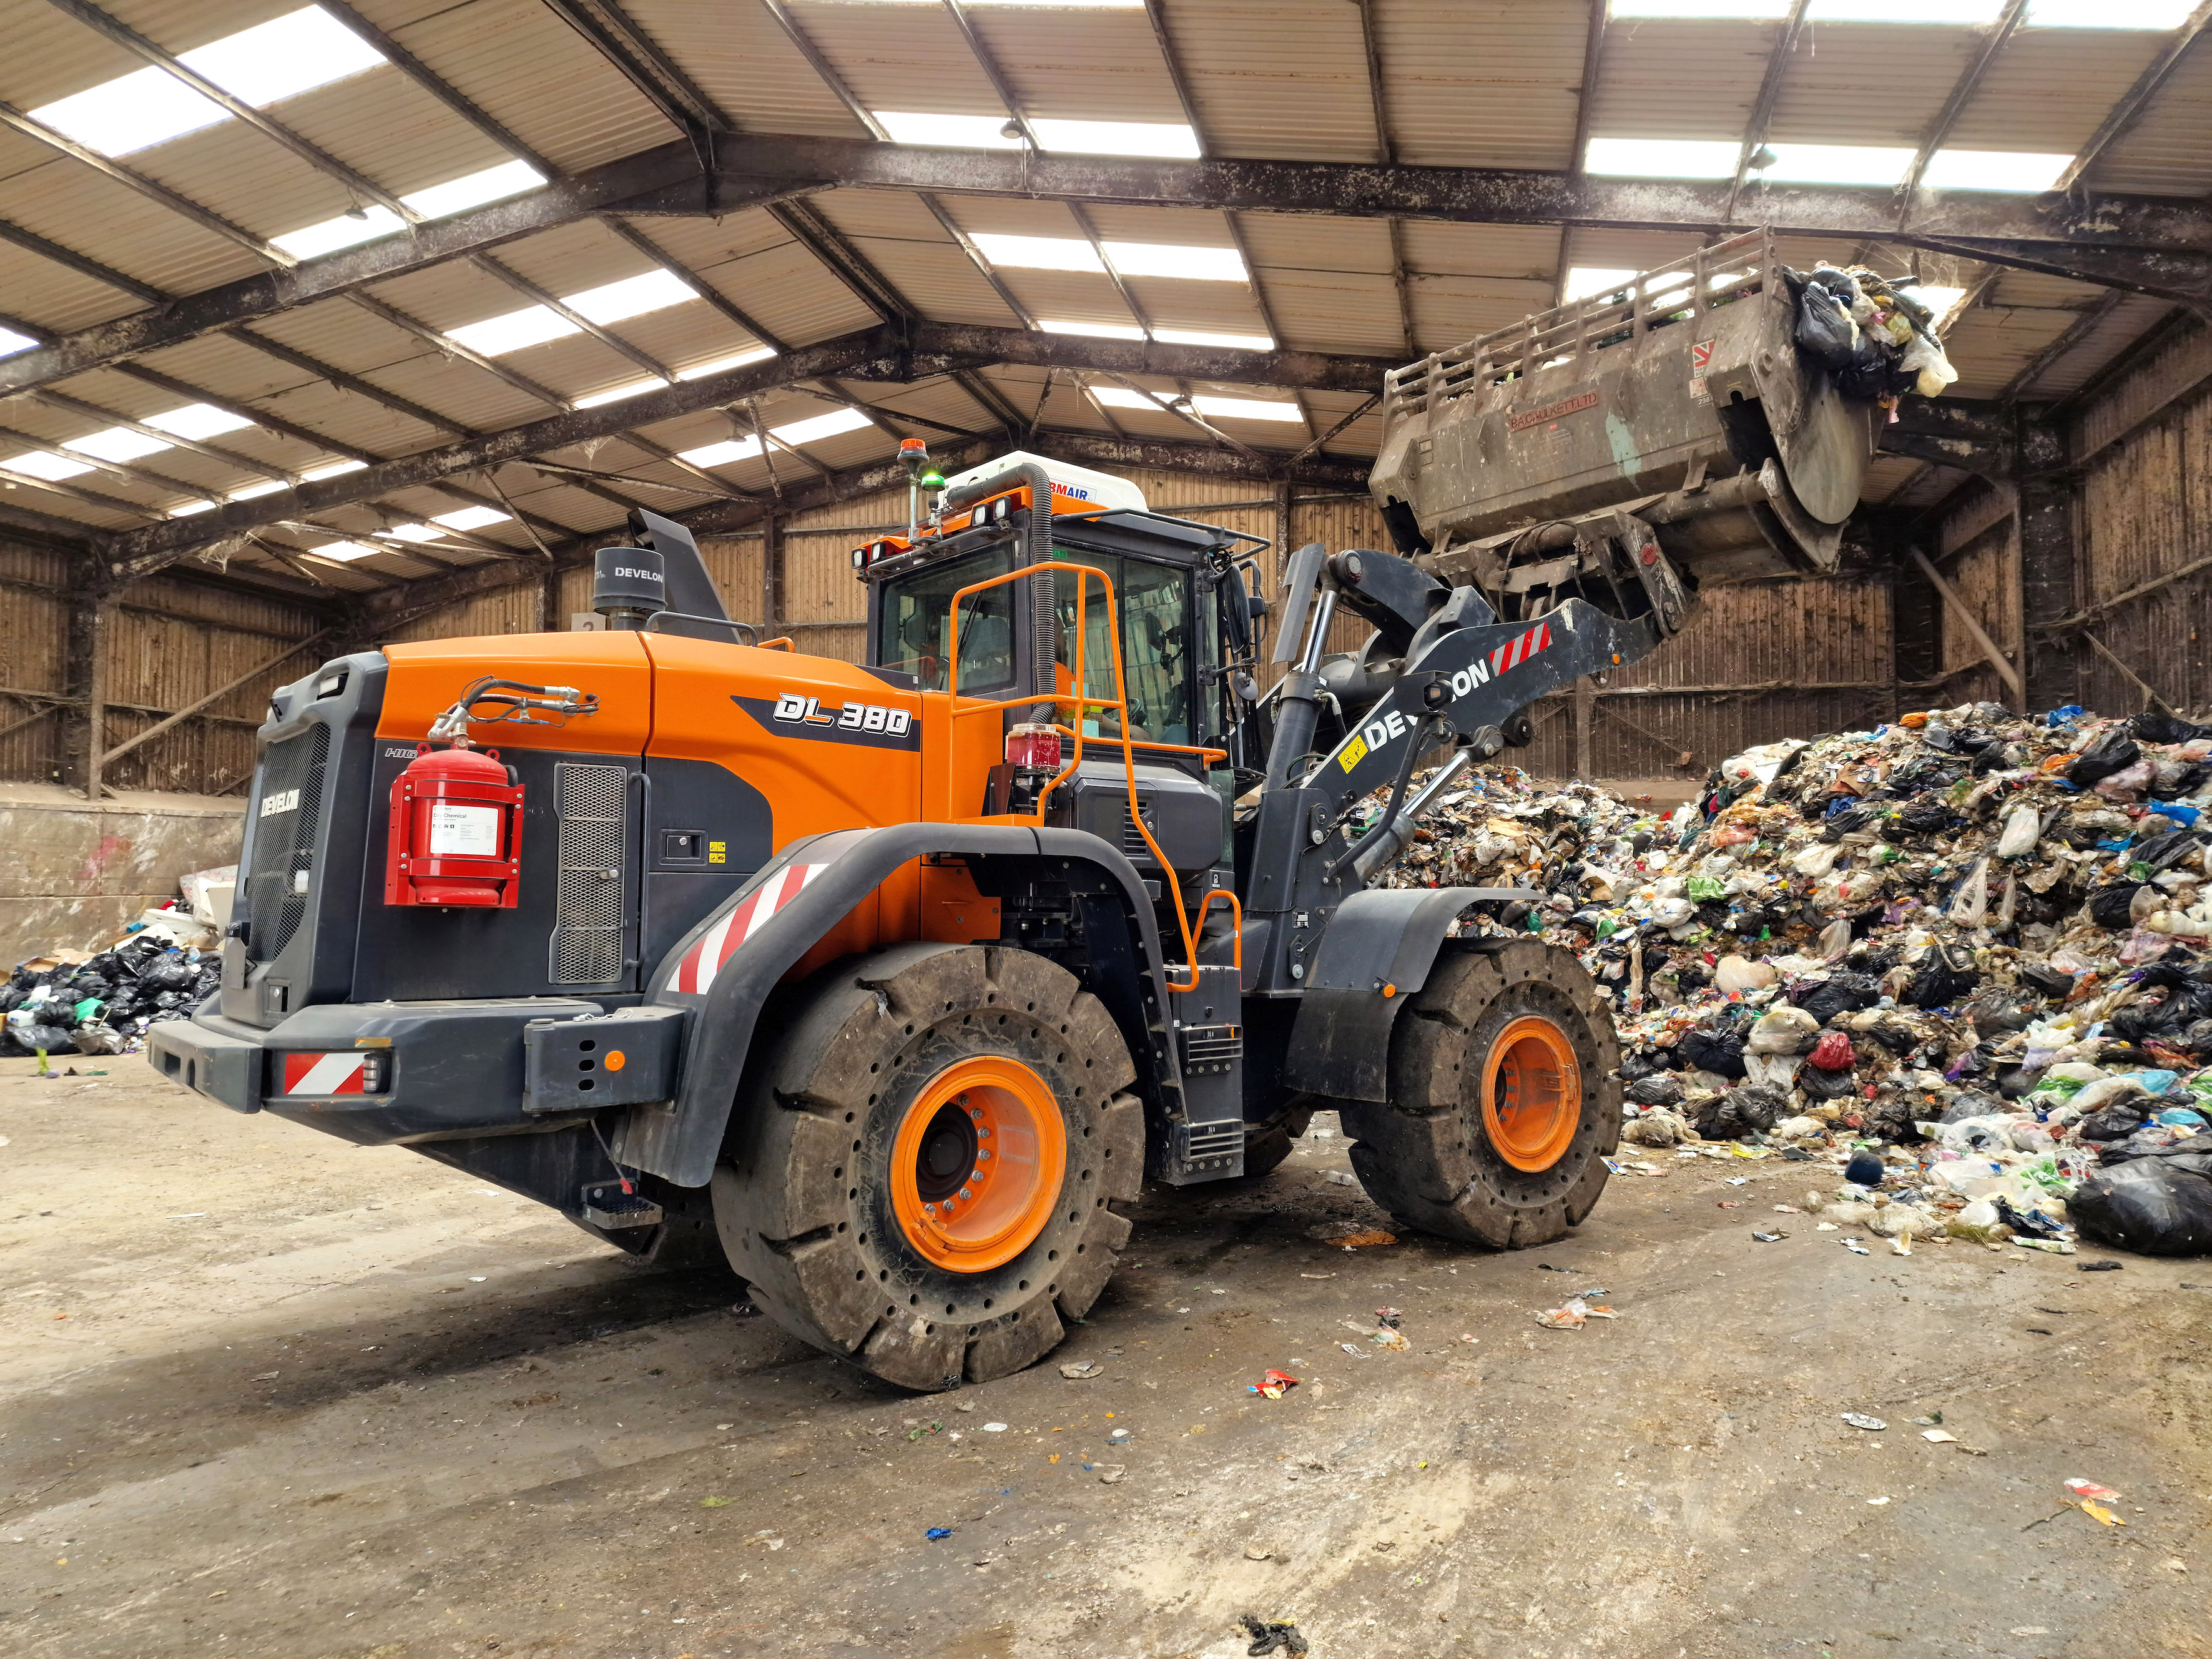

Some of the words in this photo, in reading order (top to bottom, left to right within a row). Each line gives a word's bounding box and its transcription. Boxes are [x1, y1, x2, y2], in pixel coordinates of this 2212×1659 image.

[1049, 481, 1088, 500] BMAIR
[615, 567, 663, 583] DEVELON
[773, 692, 835, 727] DL
[837, 701, 912, 737] 380
[1364, 658, 1490, 752] DEON
[261, 789, 300, 818] DEVELON
